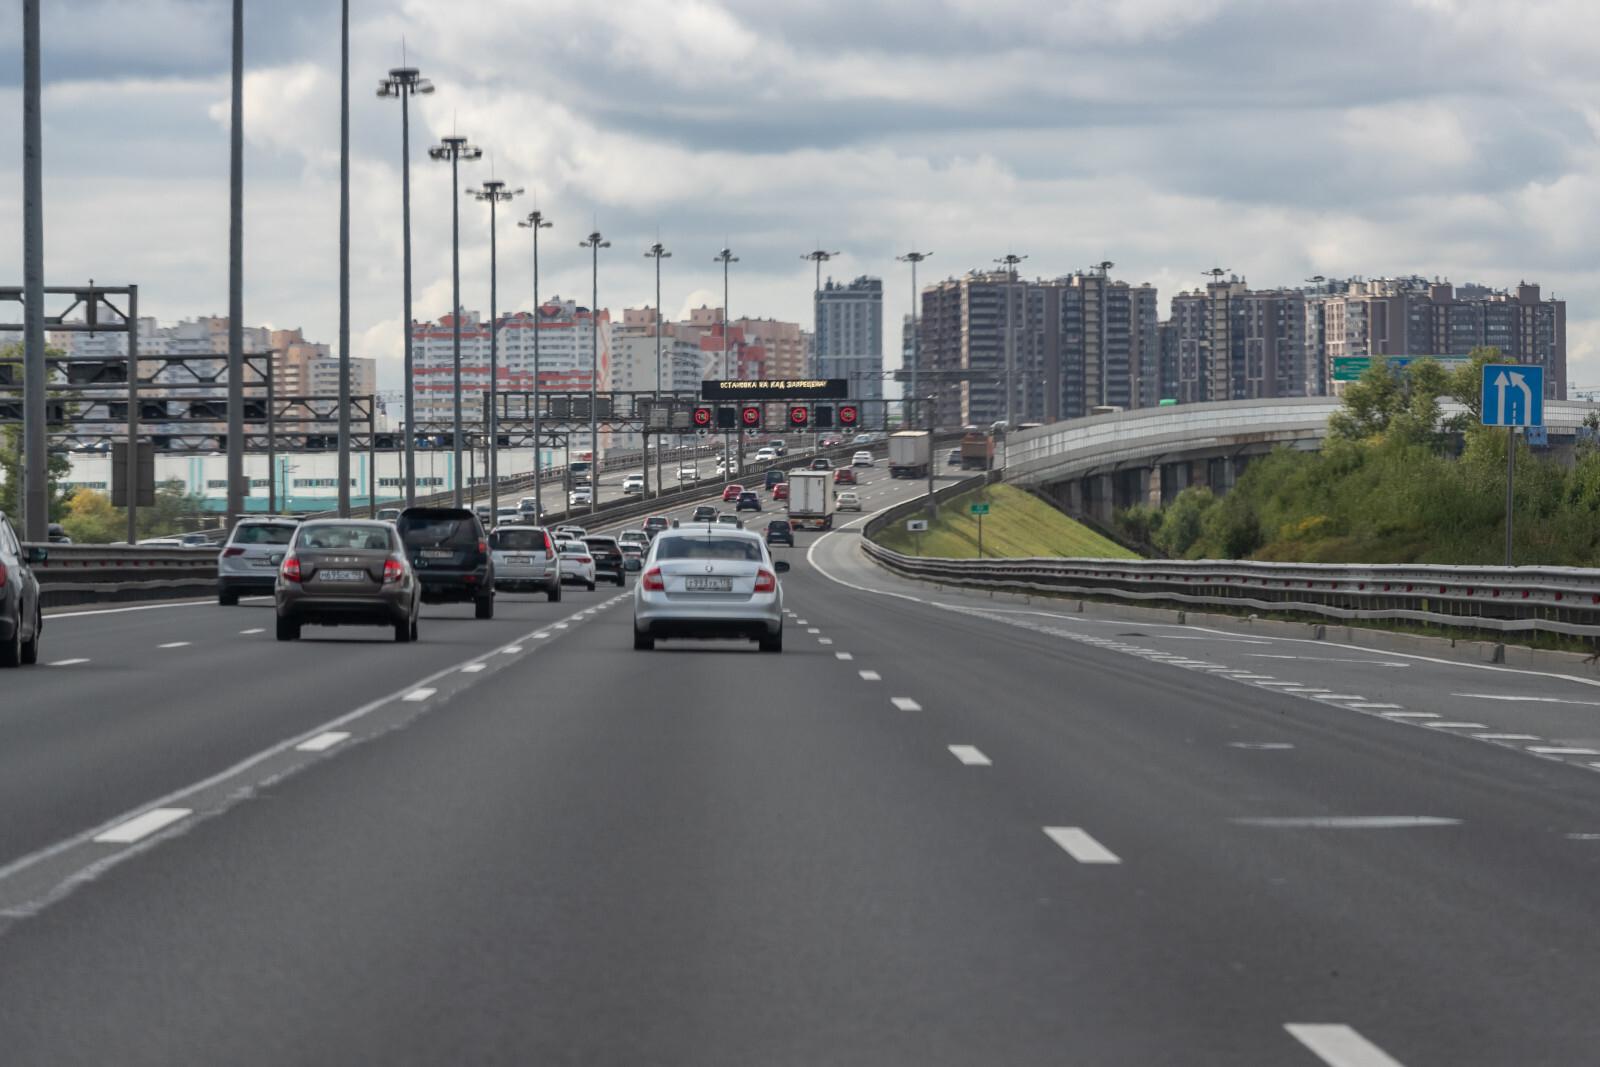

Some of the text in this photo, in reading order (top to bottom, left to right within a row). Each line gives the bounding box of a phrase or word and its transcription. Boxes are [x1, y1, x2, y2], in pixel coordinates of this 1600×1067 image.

[720, 381, 757, 389] ОСТАНОВКА
[759, 381, 769, 389] НА
[770, 381, 785, 389] КАД
